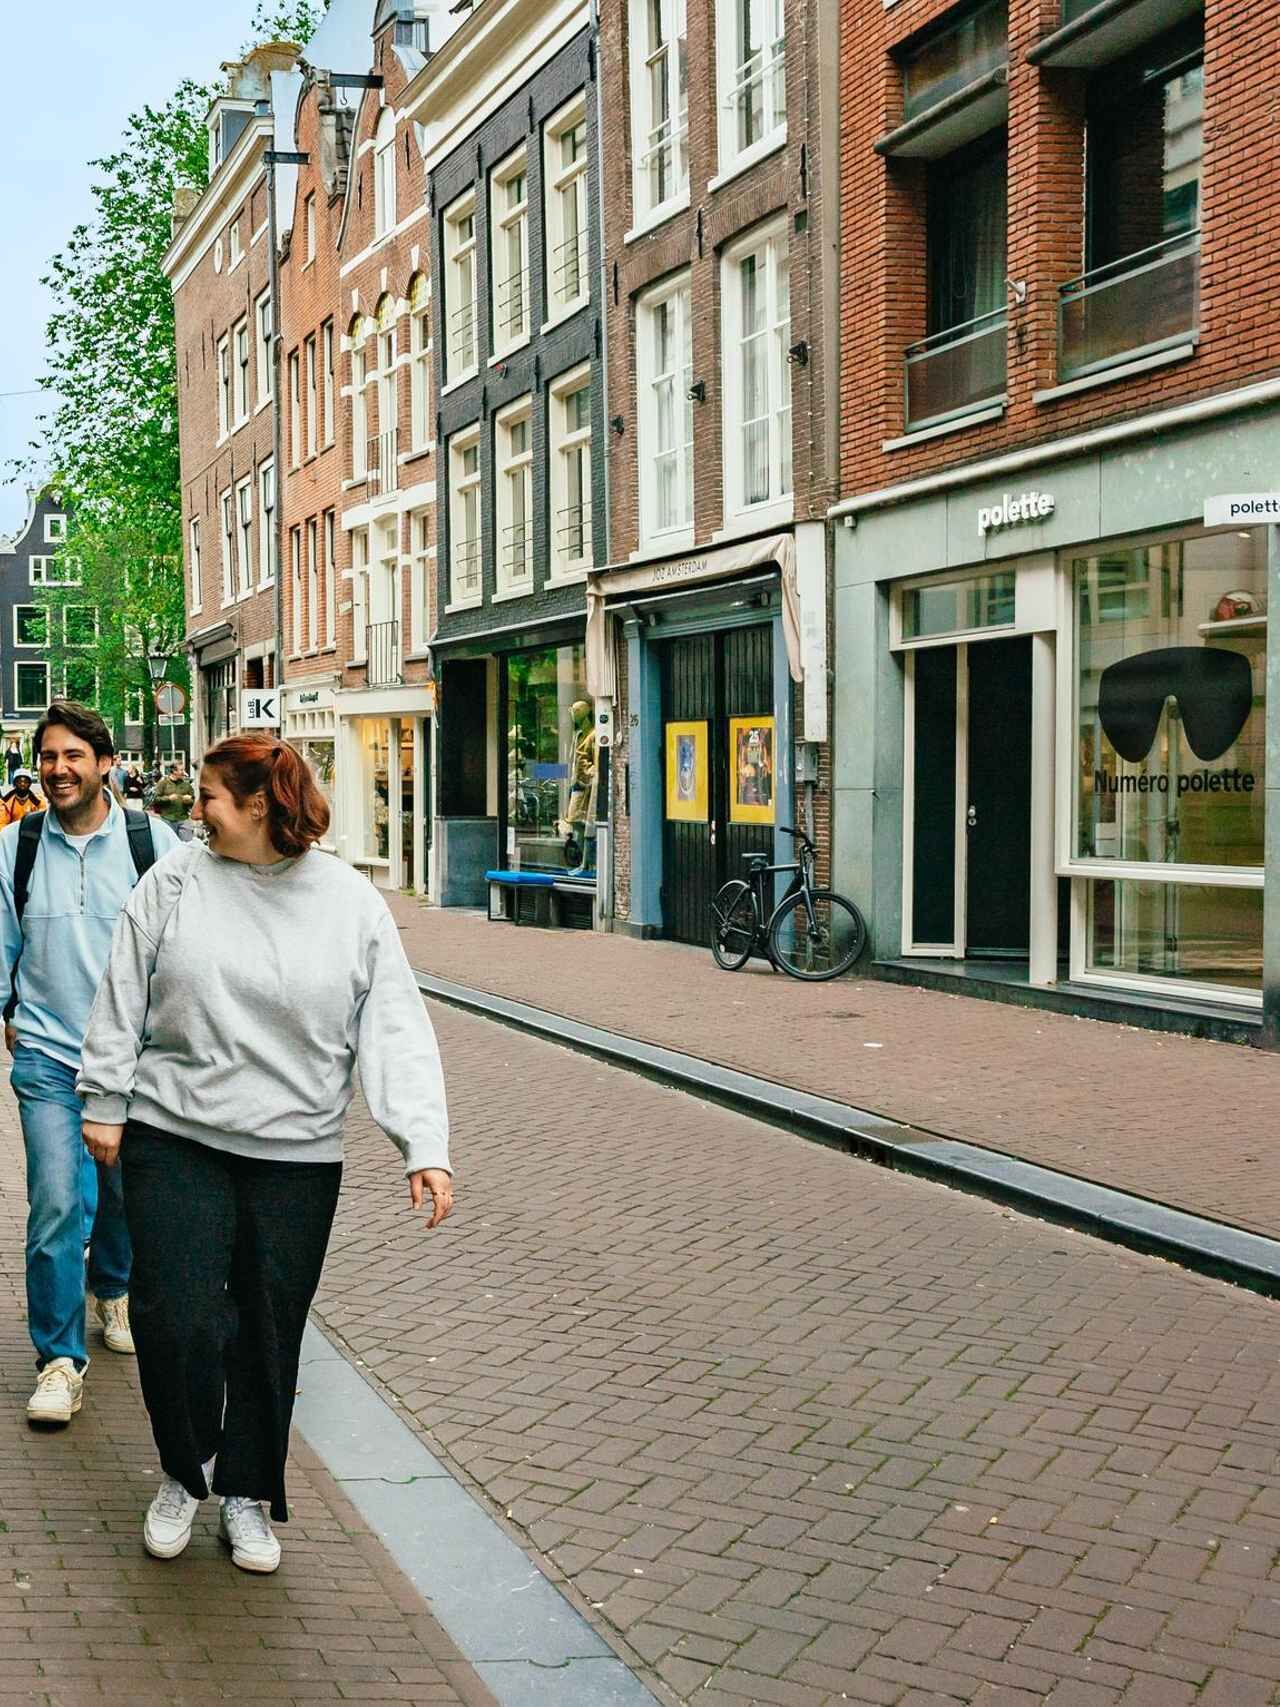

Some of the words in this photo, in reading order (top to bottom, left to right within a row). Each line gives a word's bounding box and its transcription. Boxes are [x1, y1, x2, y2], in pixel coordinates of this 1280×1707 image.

[978, 491, 1055, 536] polette
[1231, 499, 1280, 517] polett
[1094, 767, 1169, 793] Numéro
[1177, 768, 1255, 798] polette
